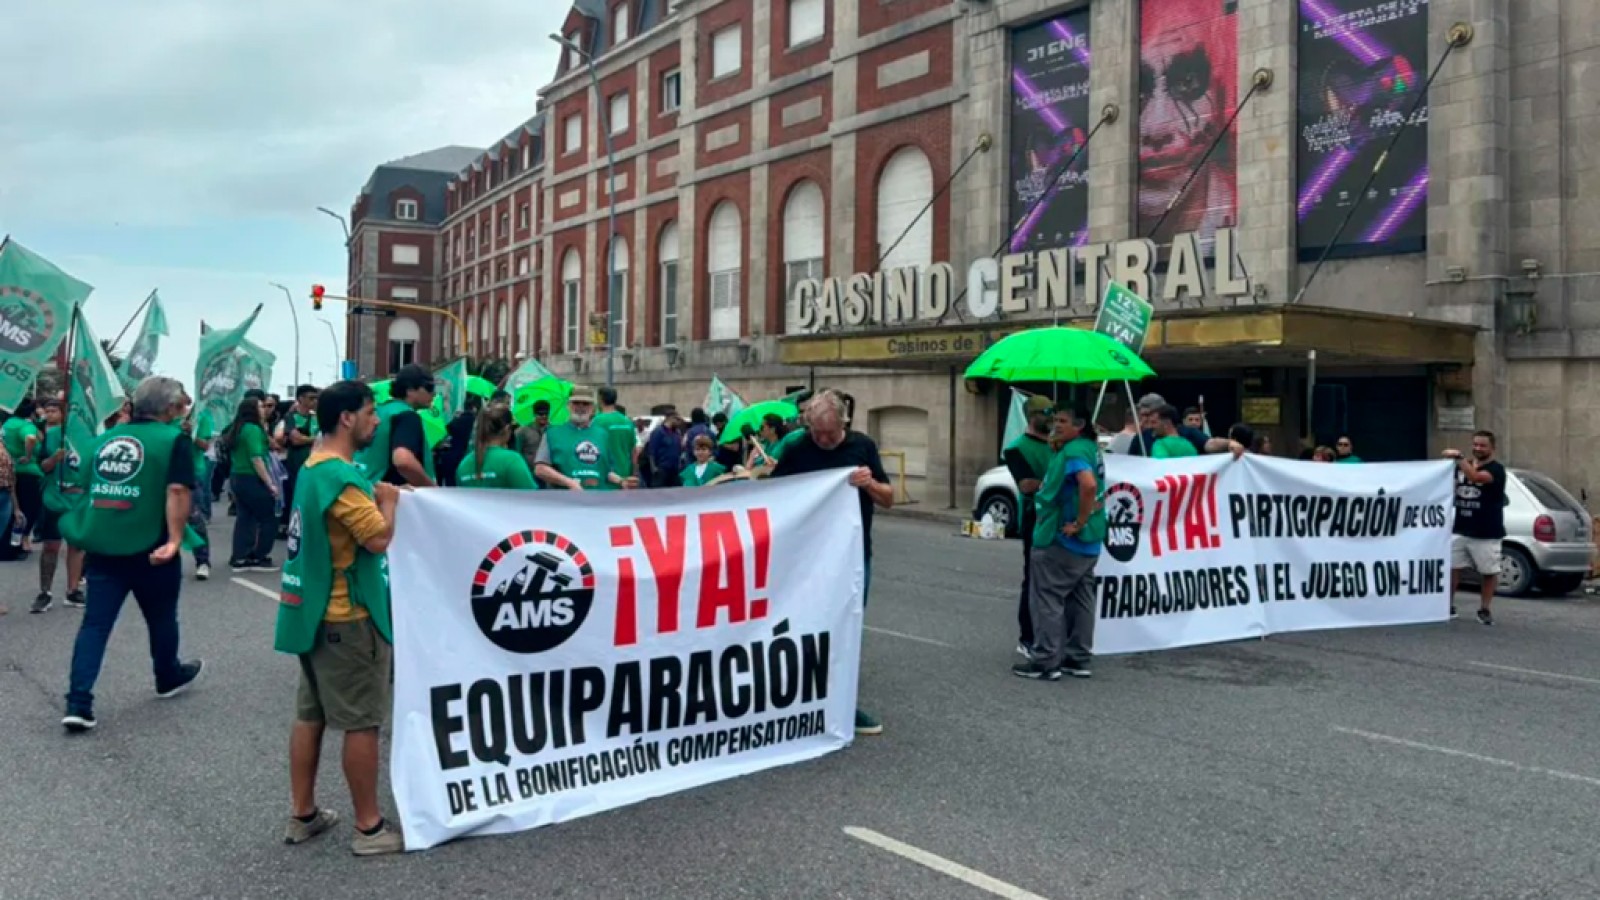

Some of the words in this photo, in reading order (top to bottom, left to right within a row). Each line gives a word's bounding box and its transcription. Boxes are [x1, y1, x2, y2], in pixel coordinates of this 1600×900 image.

[794, 261, 953, 330] CASINO
[967, 228, 1248, 318] CENTRAL
[887, 337, 948, 353] Casinos
[953, 335, 974, 351] de
[99, 460, 132, 474] AMS
[1108, 526, 1135, 546] AMS
[1151, 473, 1222, 557] ¡YA!
[1403, 505, 1420, 528] DE
[1421, 504, 1445, 528] LOS
[609, 508, 770, 646] ¡YA!
[1273, 562, 1296, 600] EL
[1301, 561, 1368, 599] JUEGO
[1374, 558, 1445, 597] ON-LINE
[491, 597, 575, 632] AMS
[430, 617, 830, 771] EQUIPARACIÓN
[446, 778, 478, 815] DE
[481, 772, 513, 806] LA
[516, 736, 662, 799] BONIFICACIÓN
[666, 708, 826, 767] COMPENSATORIA
